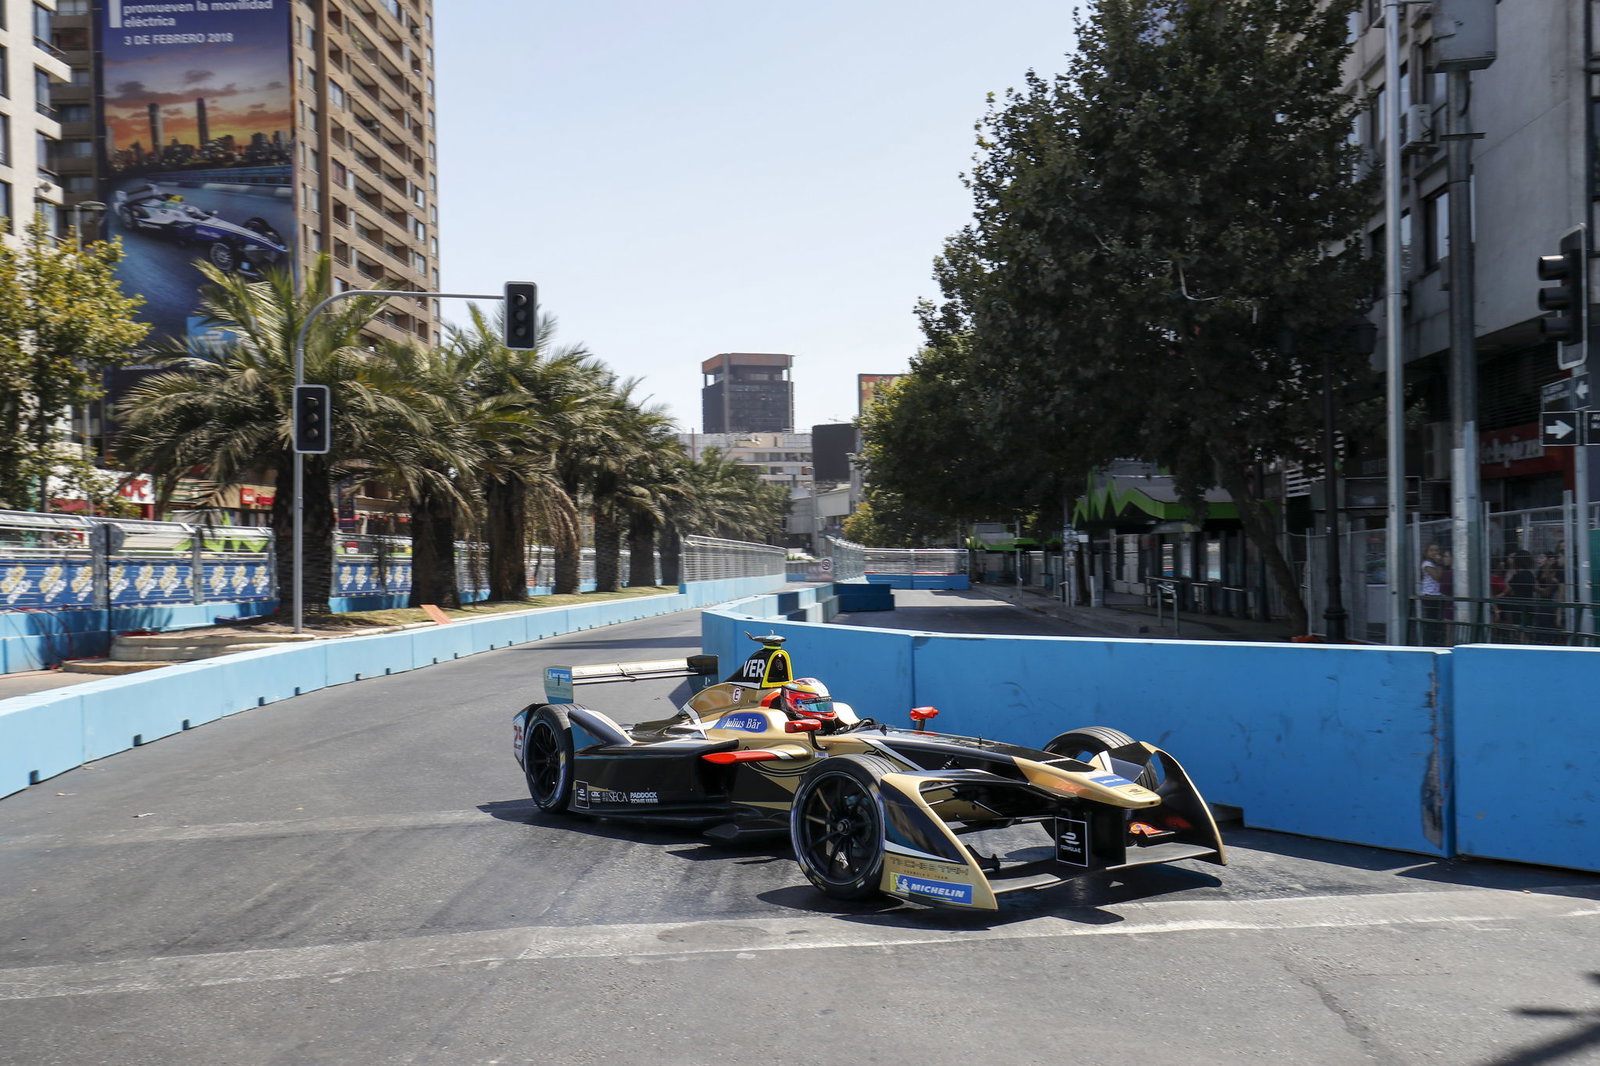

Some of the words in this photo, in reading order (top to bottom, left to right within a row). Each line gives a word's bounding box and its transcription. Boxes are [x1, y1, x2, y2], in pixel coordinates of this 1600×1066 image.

[123, 2, 194, 16] promueven
[196, 0, 209, 11] la
[211, 0, 273, 11] movilidad
[123, 16, 176, 28] eléctrica
[124, 36, 132, 45] 3
[134, 34, 150, 45] DE
[152, 33, 203, 44] FEBRERO
[207, 33, 234, 43] 2018
[742, 659, 766, 678] VER
[723, 717, 745, 729] Julius
[746, 718, 761, 729] Bär
[910, 883, 965, 898] MICHELIN
